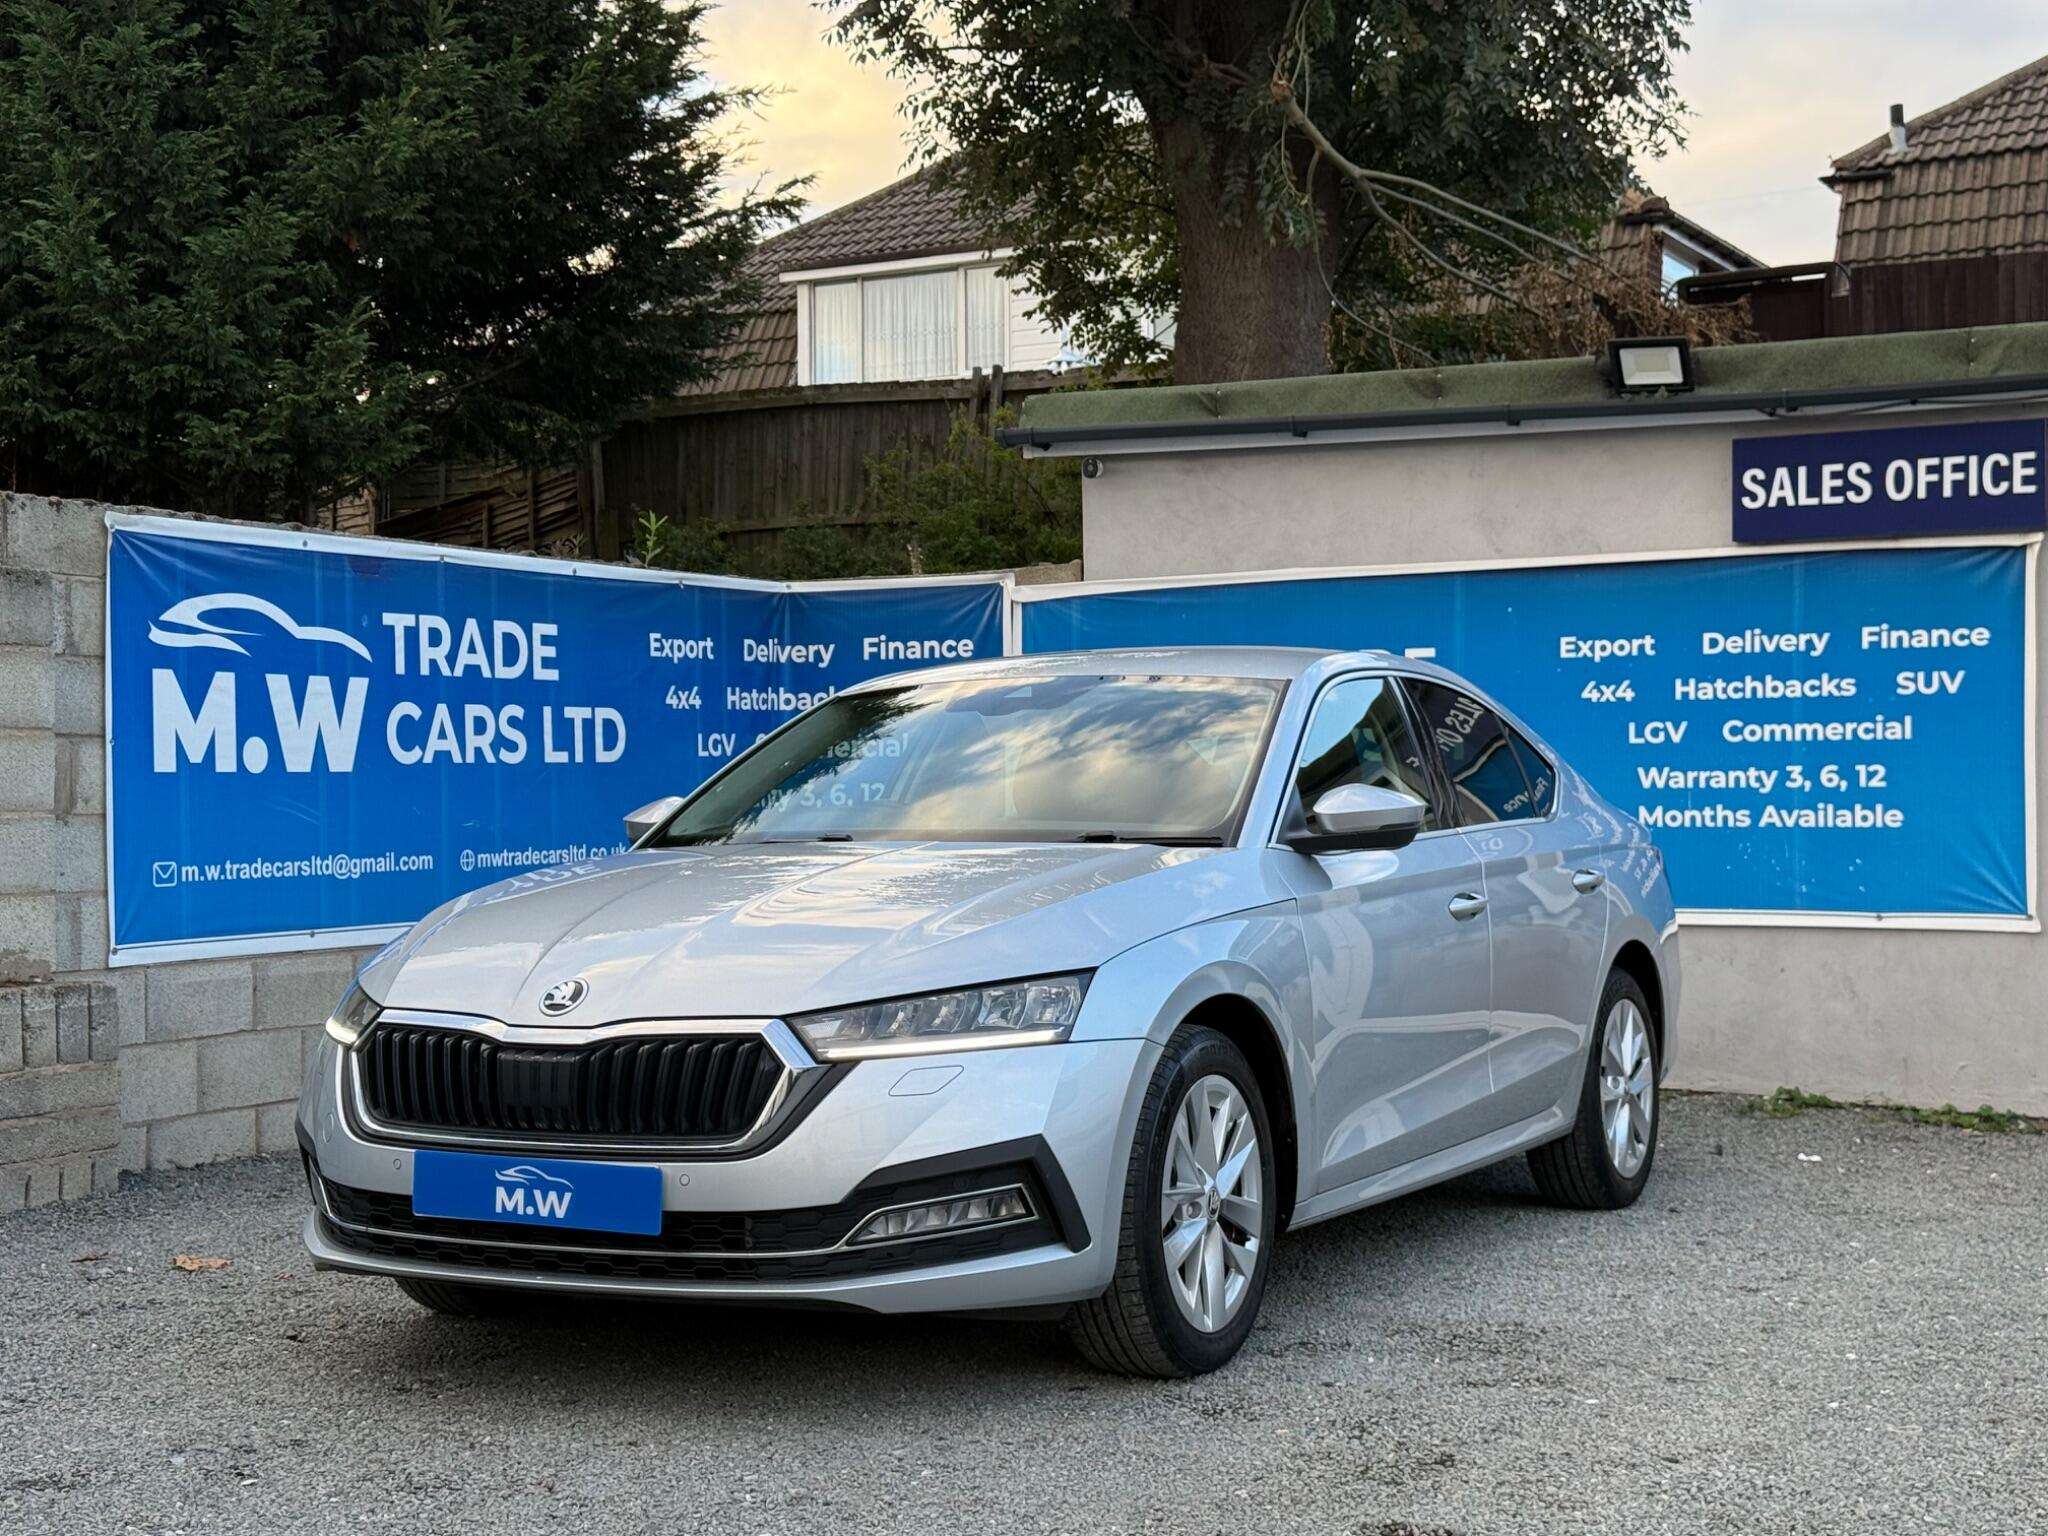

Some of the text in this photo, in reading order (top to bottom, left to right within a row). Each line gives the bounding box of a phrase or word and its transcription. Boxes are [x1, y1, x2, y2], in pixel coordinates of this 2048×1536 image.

[1742, 451, 2037, 509] SALES OFFICE
[383, 613, 559, 680] TRADE
[650, 633, 975, 668] Export Delivery Finance
[1560, 624, 1990, 662] Export Delivery Finance
[666, 685, 836, 711] 4x4 Hatchbac
[1582, 671, 1964, 702] 4x4 Hatchbacks SUV
[152, 669, 369, 773] M.W
[387, 702, 626, 764] CARS LTD
[1629, 715, 1911, 743] LGV Commercial
[698, 733, 735, 757] LGV
[1638, 764, 1886, 793] Warranty 3, 6, 12
[831, 784, 853, 806] 6,
[861, 782, 885, 801] 12
[1638, 803, 1904, 828] Months Available
[182, 852, 433, 880] m.w.tradecarsltd@gmail.com
[478, 842, 628, 867] mwtradecarsltdcouk
[495, 1187, 573, 1219] M.W
